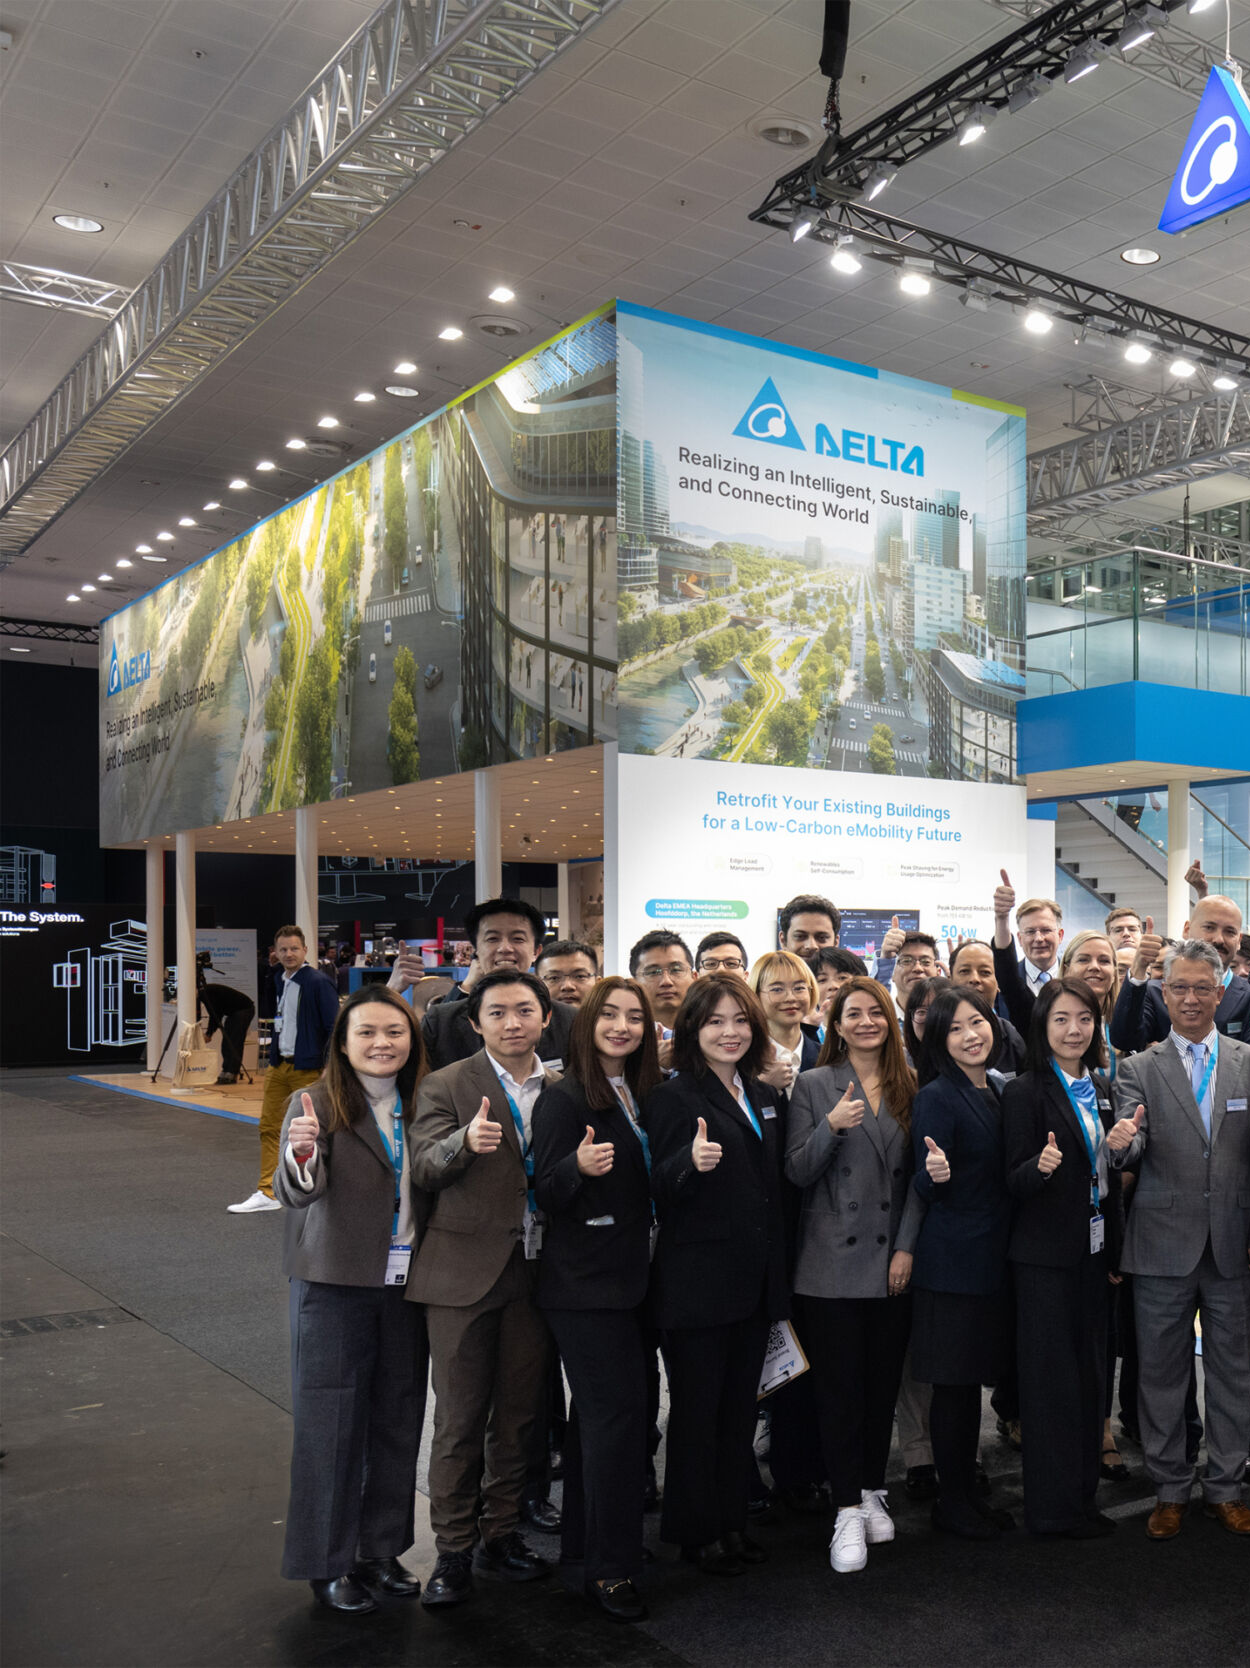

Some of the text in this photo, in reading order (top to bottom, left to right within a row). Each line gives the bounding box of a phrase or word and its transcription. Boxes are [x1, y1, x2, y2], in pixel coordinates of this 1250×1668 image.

[815, 423, 924, 477] DELTA
[678, 476, 869, 524] and Connecting World
[679, 446, 973, 524] Realizing an Intelligent, Sustainable,
[123, 648, 150, 690] DELTA
[106, 714, 130, 740] Realizing
[140, 699, 173, 726] Intelligent,
[174, 678, 217, 712] Sustainable,
[117, 740, 150, 768] Connecting
[151, 730, 170, 756] World
[717, 791, 951, 822] Retrofit Your Existing Buildings
[702, 813, 962, 842] for a Low-Carbon eMobility Future
[0, 911, 84, 924] The System.
[691, 903, 732, 911] Headquarters
[941, 925, 977, 938] 50 kW
